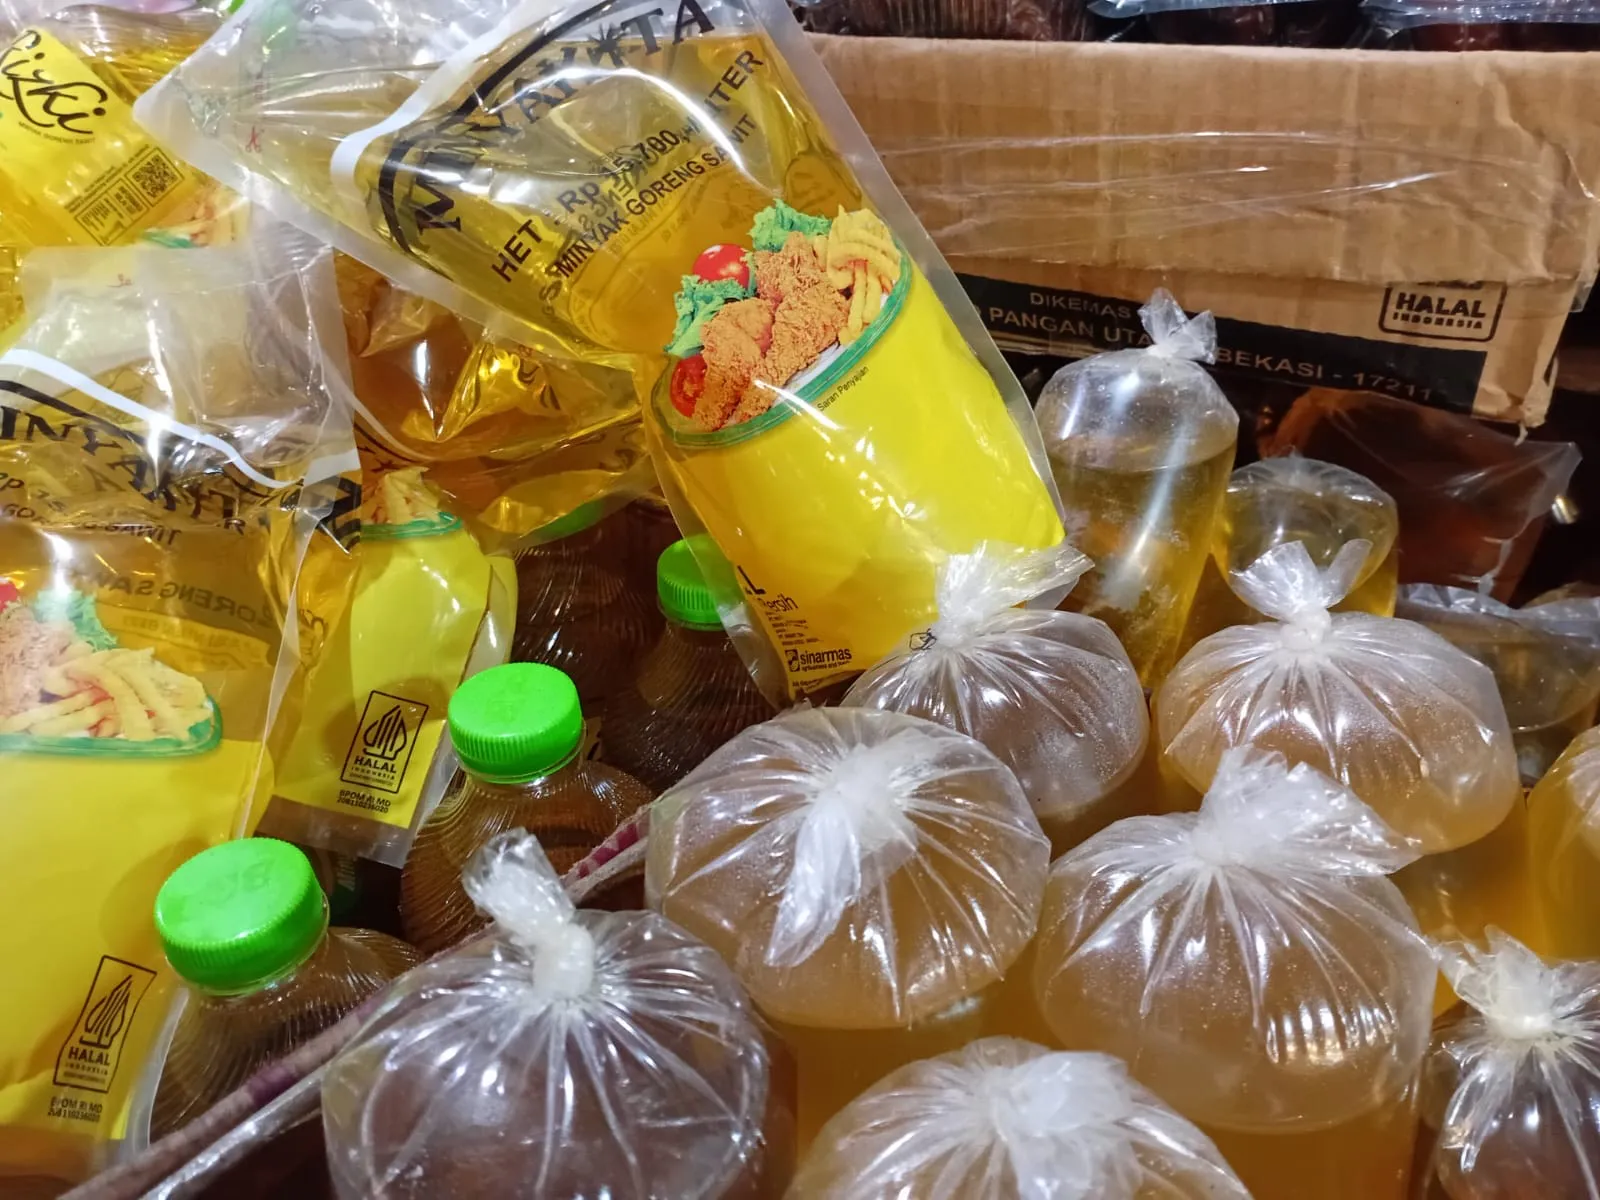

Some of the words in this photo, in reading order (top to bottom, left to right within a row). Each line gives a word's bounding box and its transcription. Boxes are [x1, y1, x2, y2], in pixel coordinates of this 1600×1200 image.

[555, 210, 630, 278] MINYAK
[625, 160, 706, 216] GORENG
[491, 219, 542, 283] HET
[559, 181, 600, 213] Rp
[1030, 291, 1132, 319] DIKEMAS
[1395, 292, 1487, 318] HALAL
[1392, 311, 1483, 330] INDONESIA
[989, 306, 1095, 338] PANGAN
[1216, 346, 1324, 380] BEKASI
[817, 392, 840, 412] Saran
[800, 647, 853, 666] sinarmas
[354, 755, 397, 774] HALAL
[376, 798, 391, 808] MD
[68, 1046, 111, 1066] HALAL
